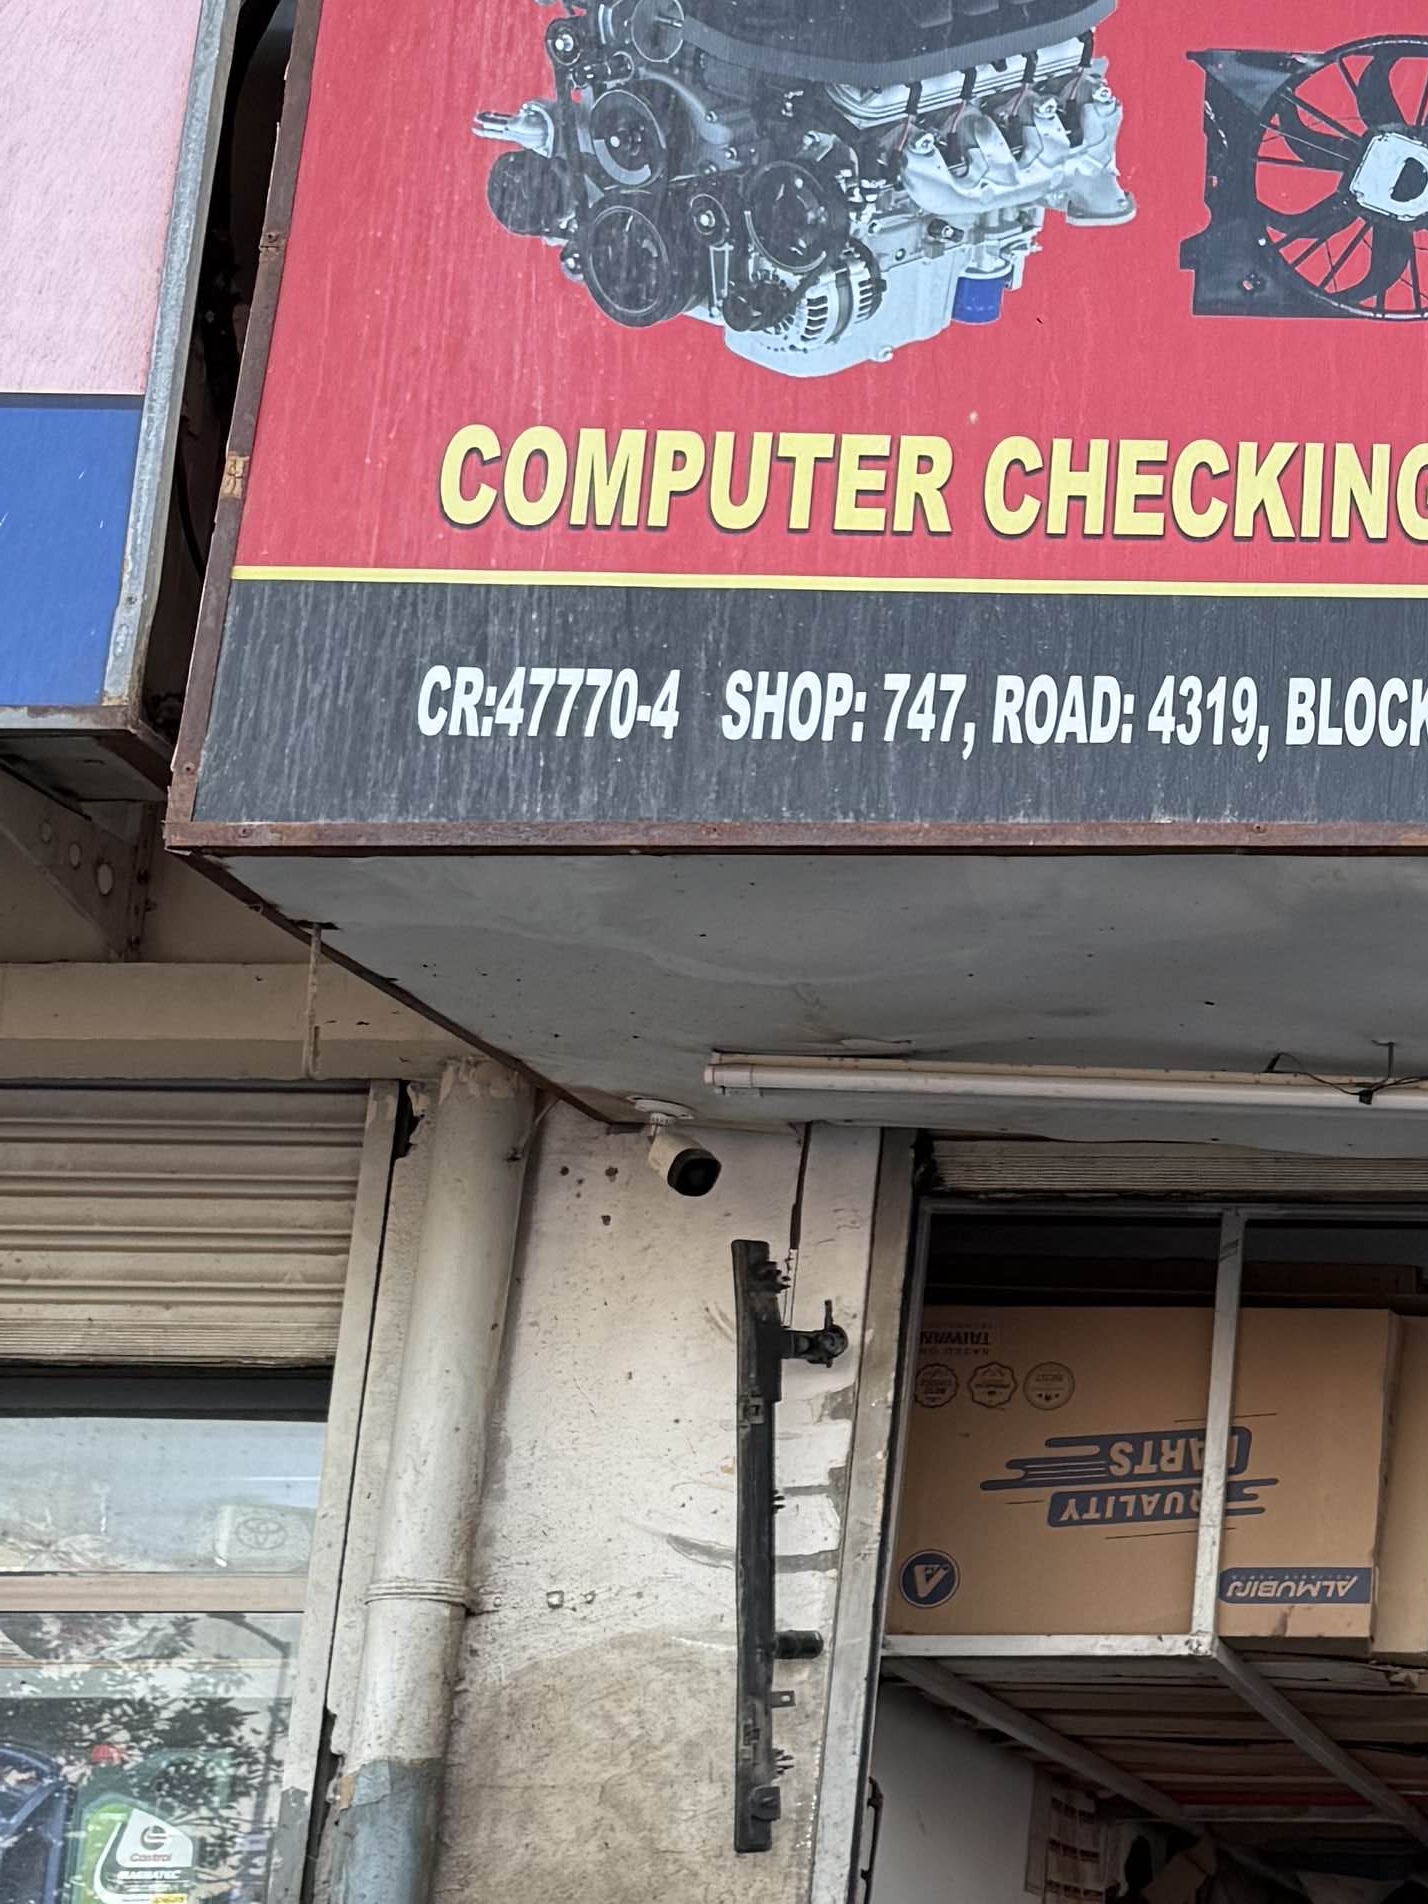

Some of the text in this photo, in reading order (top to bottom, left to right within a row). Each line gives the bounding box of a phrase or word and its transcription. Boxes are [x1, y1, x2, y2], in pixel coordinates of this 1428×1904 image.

[438, 424, 954, 537] COMPUTER
[416, 666, 681, 739] CR:47770-4
[720, 669, 868, 743] SHOP:
[881, 672, 978, 759] 747,
[991, 673, 1135, 747] ROAD:
[1145, 675, 1271, 764] 4319,
